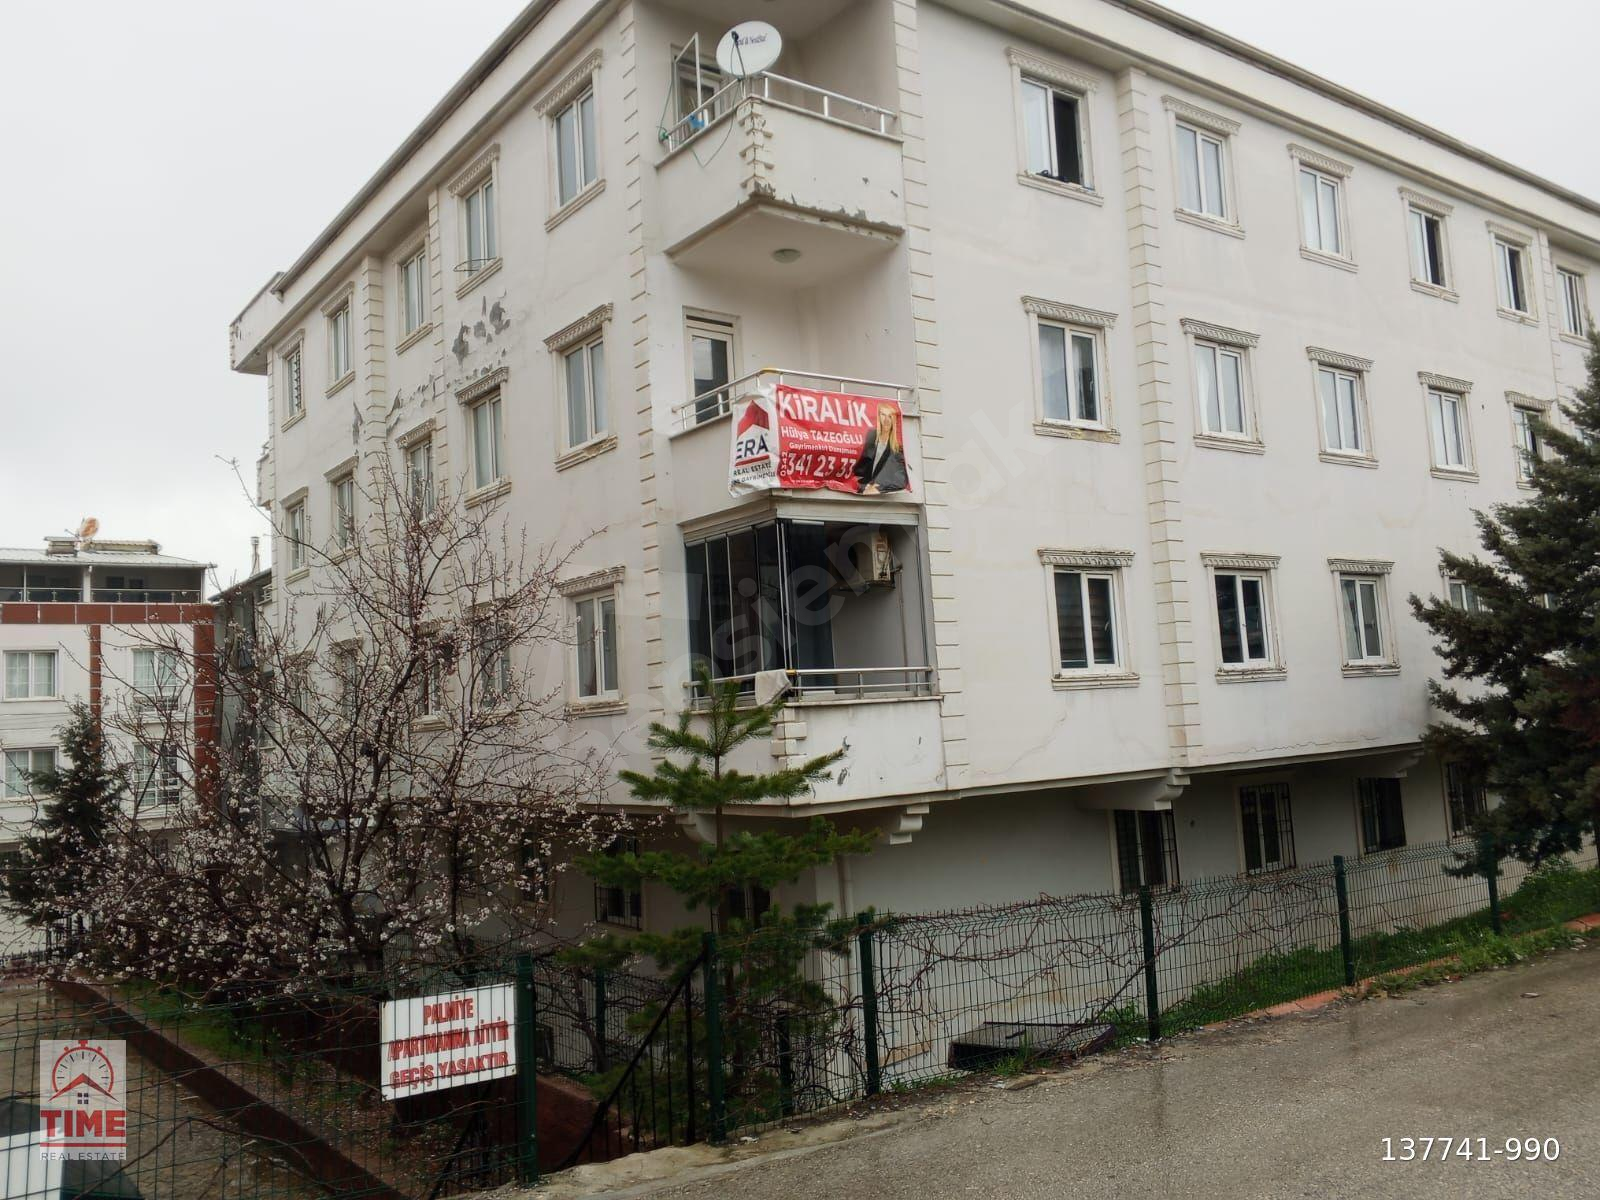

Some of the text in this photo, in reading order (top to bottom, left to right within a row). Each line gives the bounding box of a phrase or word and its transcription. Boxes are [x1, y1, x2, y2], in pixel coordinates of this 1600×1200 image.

[736, 434, 769, 459] ERA
[781, 426, 863, 445] Hülya TAZEOĞLU
[787, 453, 812, 477] 341
[814, 456, 834, 478] 23
[423, 995, 474, 1025] PALMİYE
[389, 1051, 509, 1090] GEÇİŞ YASAKTIR
